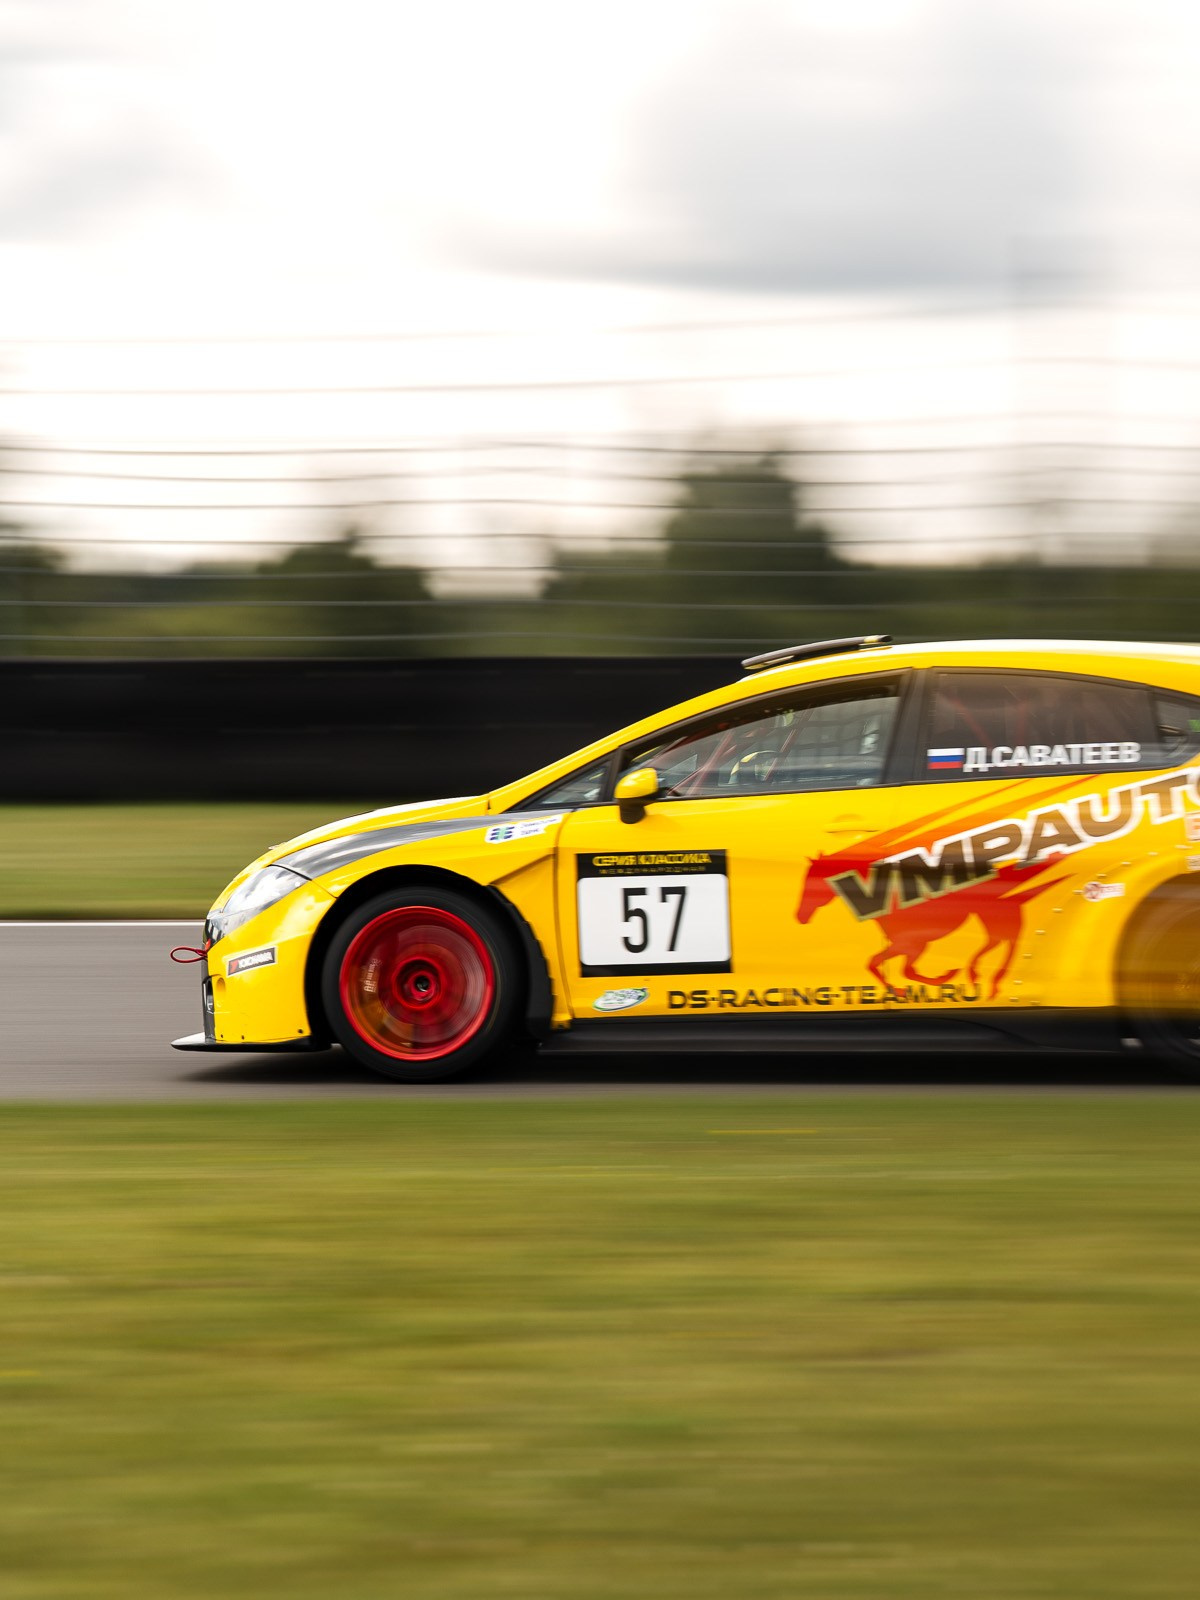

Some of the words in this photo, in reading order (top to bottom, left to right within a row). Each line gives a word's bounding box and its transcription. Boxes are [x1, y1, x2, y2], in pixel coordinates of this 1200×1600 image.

[963, 742, 1141, 772] Д.САВАТЕЕВ
[592, 855, 637, 867] СЕРИЯ
[638, 853, 712, 865] КЛАССИКА
[622, 886, 687, 953] 57
